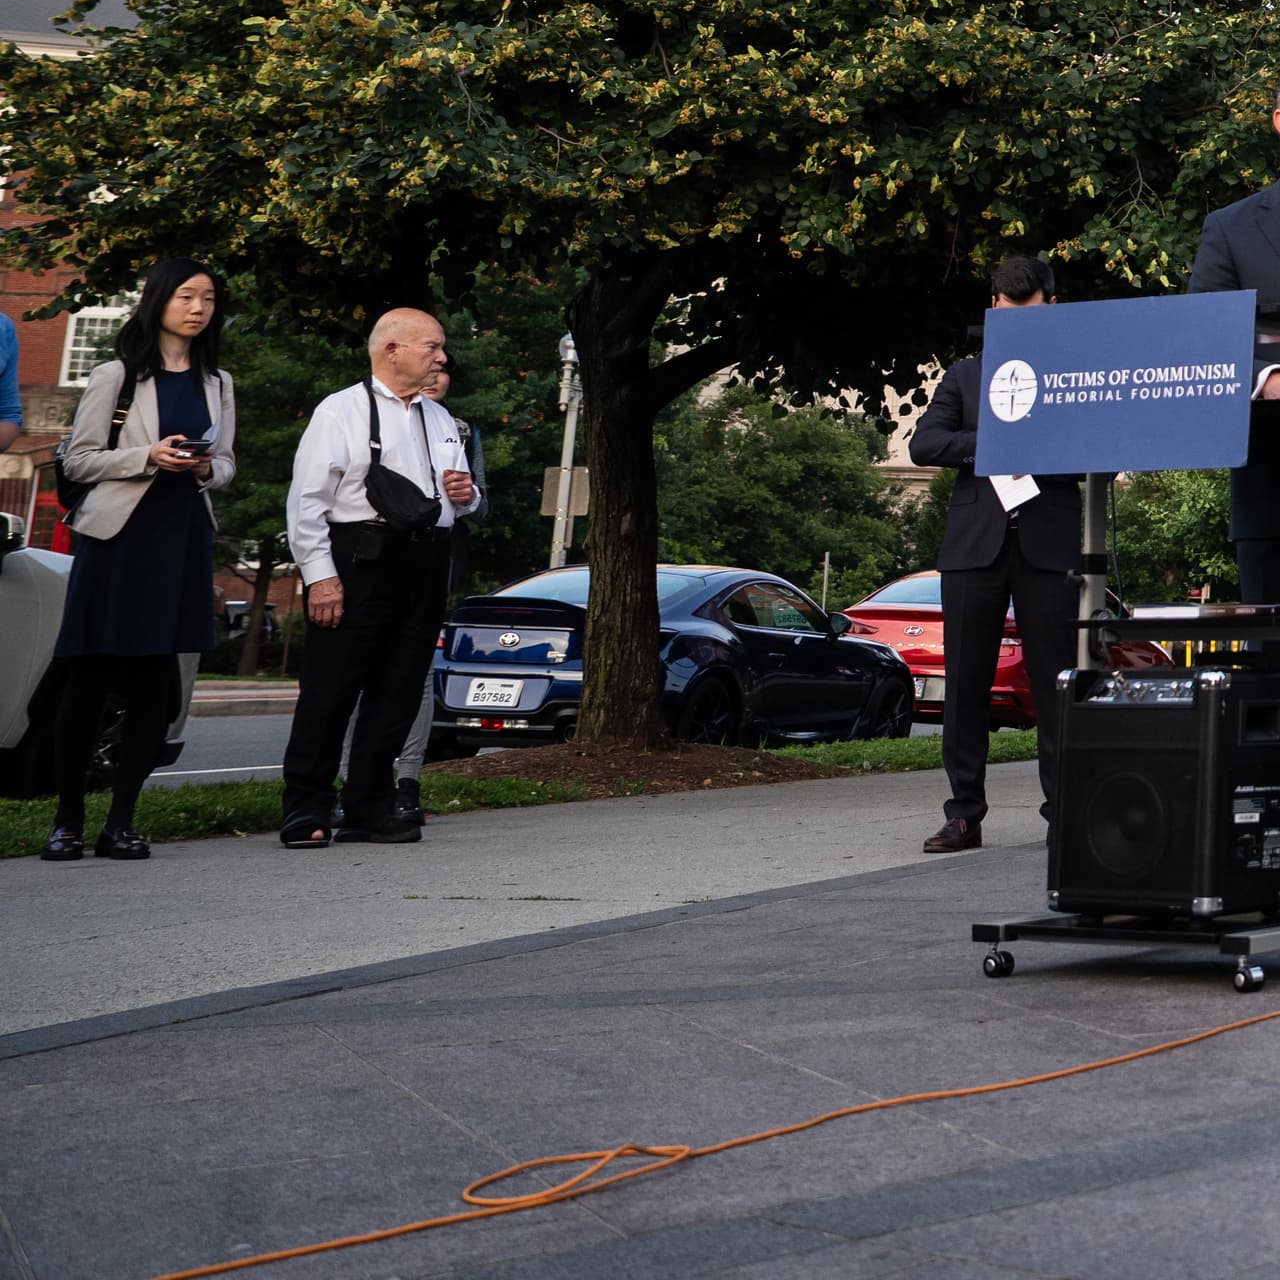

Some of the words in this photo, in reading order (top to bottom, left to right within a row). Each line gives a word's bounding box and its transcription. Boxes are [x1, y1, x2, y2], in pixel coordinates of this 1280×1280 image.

[1043, 370, 1106, 389] VICTIMS
[1108, 369, 1131, 386] OF
[1132, 363, 1236, 385] COMMUNISM
[1043, 389, 1123, 404] MEMORIAL
[473, 692, 512, 703] B97582
